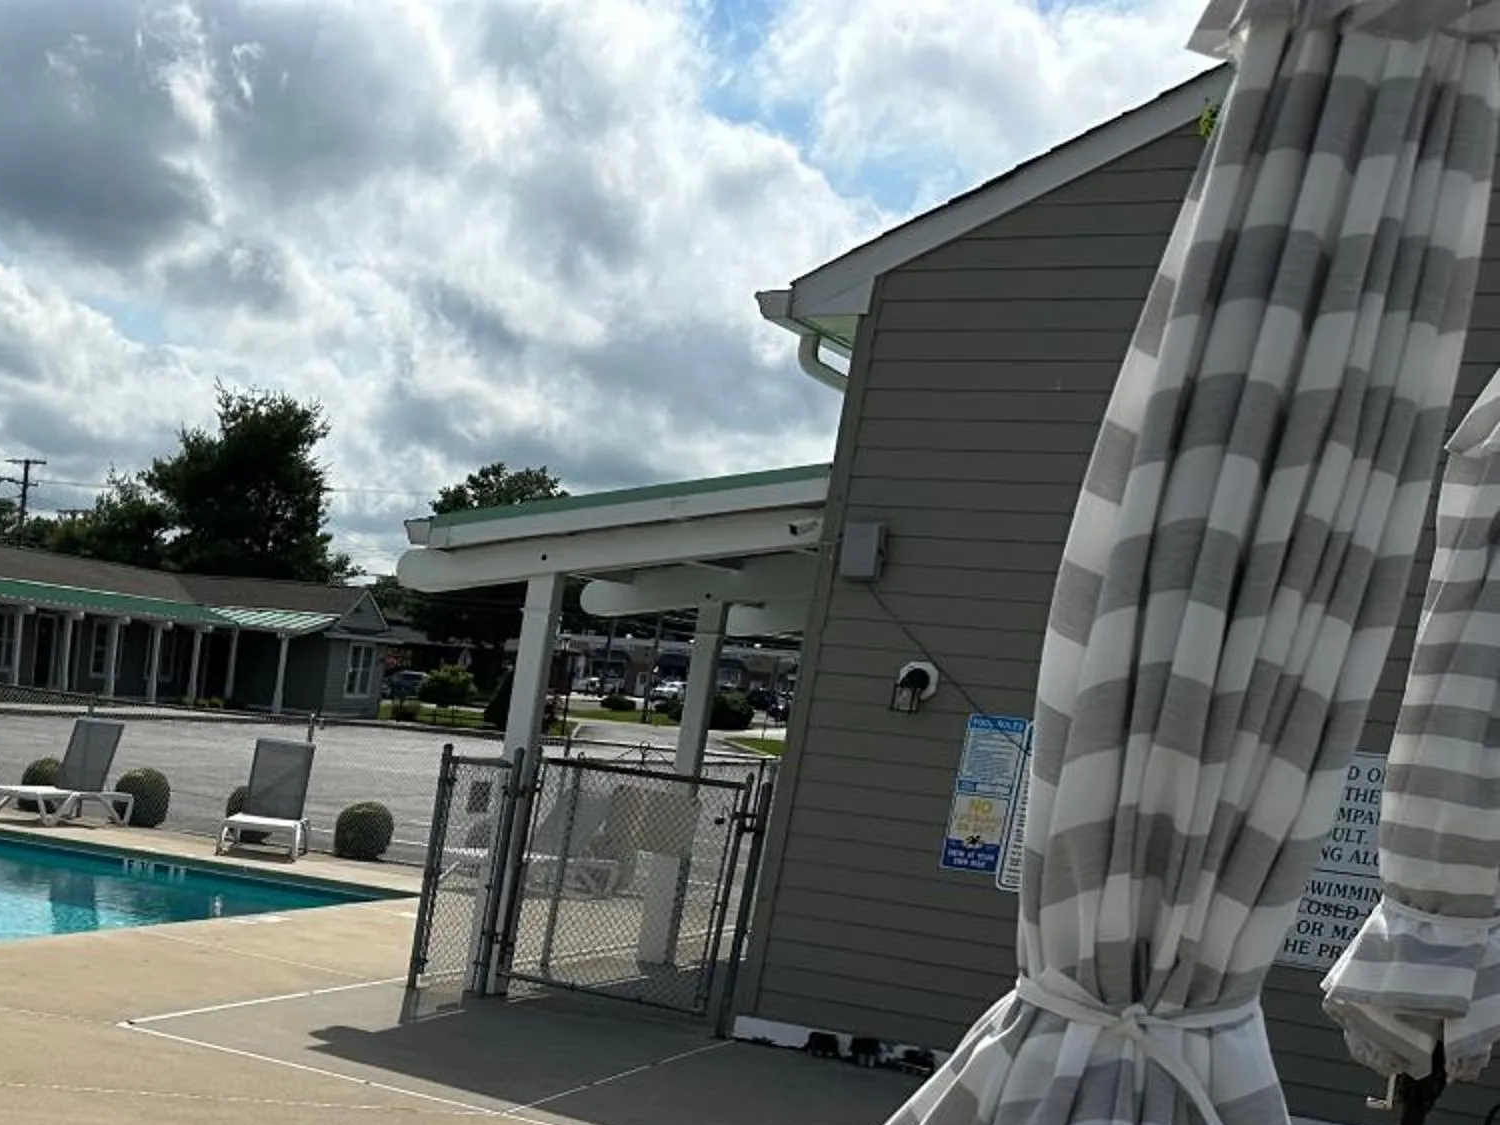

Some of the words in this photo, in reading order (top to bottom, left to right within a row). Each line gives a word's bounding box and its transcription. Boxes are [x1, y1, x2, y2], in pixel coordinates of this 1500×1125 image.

[1367, 767, 1385, 784] O
[1345, 786, 1381, 804] THE
[969, 798, 993, 814] NO
[1330, 827, 1369, 845] ULT.
[1318, 943, 1348, 960] PR
